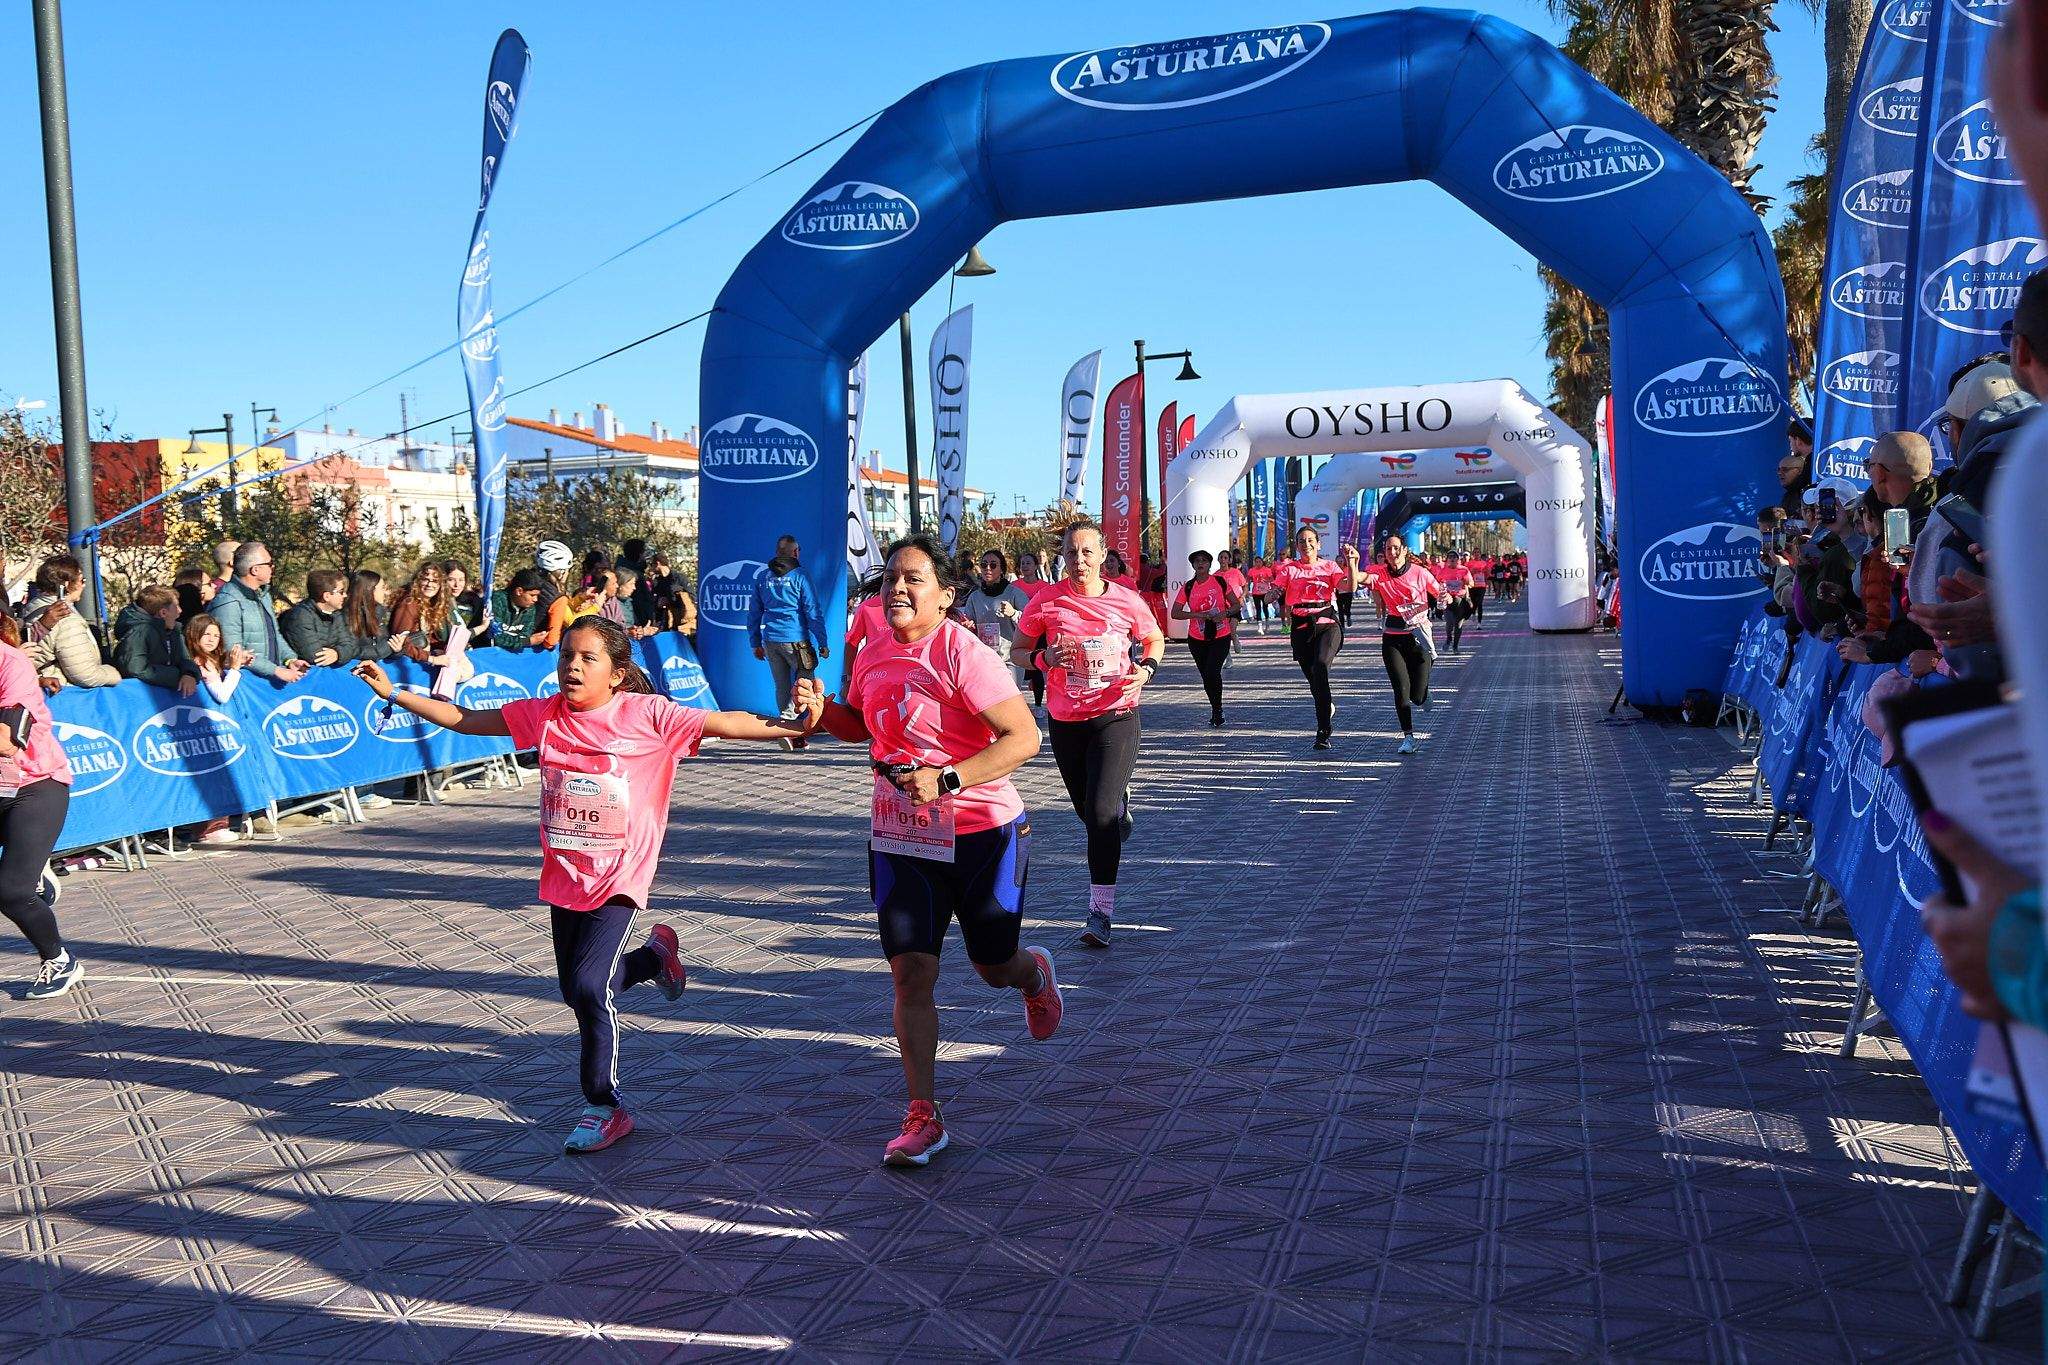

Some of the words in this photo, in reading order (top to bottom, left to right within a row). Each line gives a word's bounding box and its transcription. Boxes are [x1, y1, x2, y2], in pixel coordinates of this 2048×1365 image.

[1069, 32, 1309, 90] ASTURIANA
[1529, 151, 1585, 165] CENTRAL
[1591, 145, 1644, 157] LECHERA
[1507, 153, 1653, 190] ASTURIANA
[810, 203, 852, 215] CENTRAL
[855, 202, 903, 210] LECHERA
[789, 212, 908, 236] ASTURIANA
[1836, 280, 1905, 306] ASTUR
[1934, 275, 2023, 311] ASTUR
[1665, 384, 1720, 396] CENTRAL
[1643, 391, 1775, 421] ASTURIANA
[1285, 398, 1453, 439] OYSHO
[715, 437, 754, 446] CENTRAL
[758, 437, 805, 447] LECHERA
[1503, 428, 1556, 443] OYSHO
[704, 441, 809, 467] ASTURIANA
[1116, 402, 1130, 490] Santander
[1190, 448, 1238, 461] OYSHO
[1820, 453, 1870, 480] ASTUR
[1420, 492, 1505, 505] VOLVO
[1534, 498, 1584, 512] OYSHO
[1170, 514, 1215, 527] OYSHO
[1118, 519, 1130, 561] ports
[1671, 550, 1725, 558] CENTRAL
[1730, 546, 1759, 556] LECH
[1536, 566, 1585, 581] OYSHO
[1649, 553, 1771, 582] ASTURIAN
[714, 583, 753, 591] CENTRAL
[1083, 659, 1105, 669] 016
[272, 722, 355, 748] ASTURIANA
[146, 733, 240, 764] ASTURIANA
[567, 808, 600, 822] 016
[899, 812, 929, 828] 016
